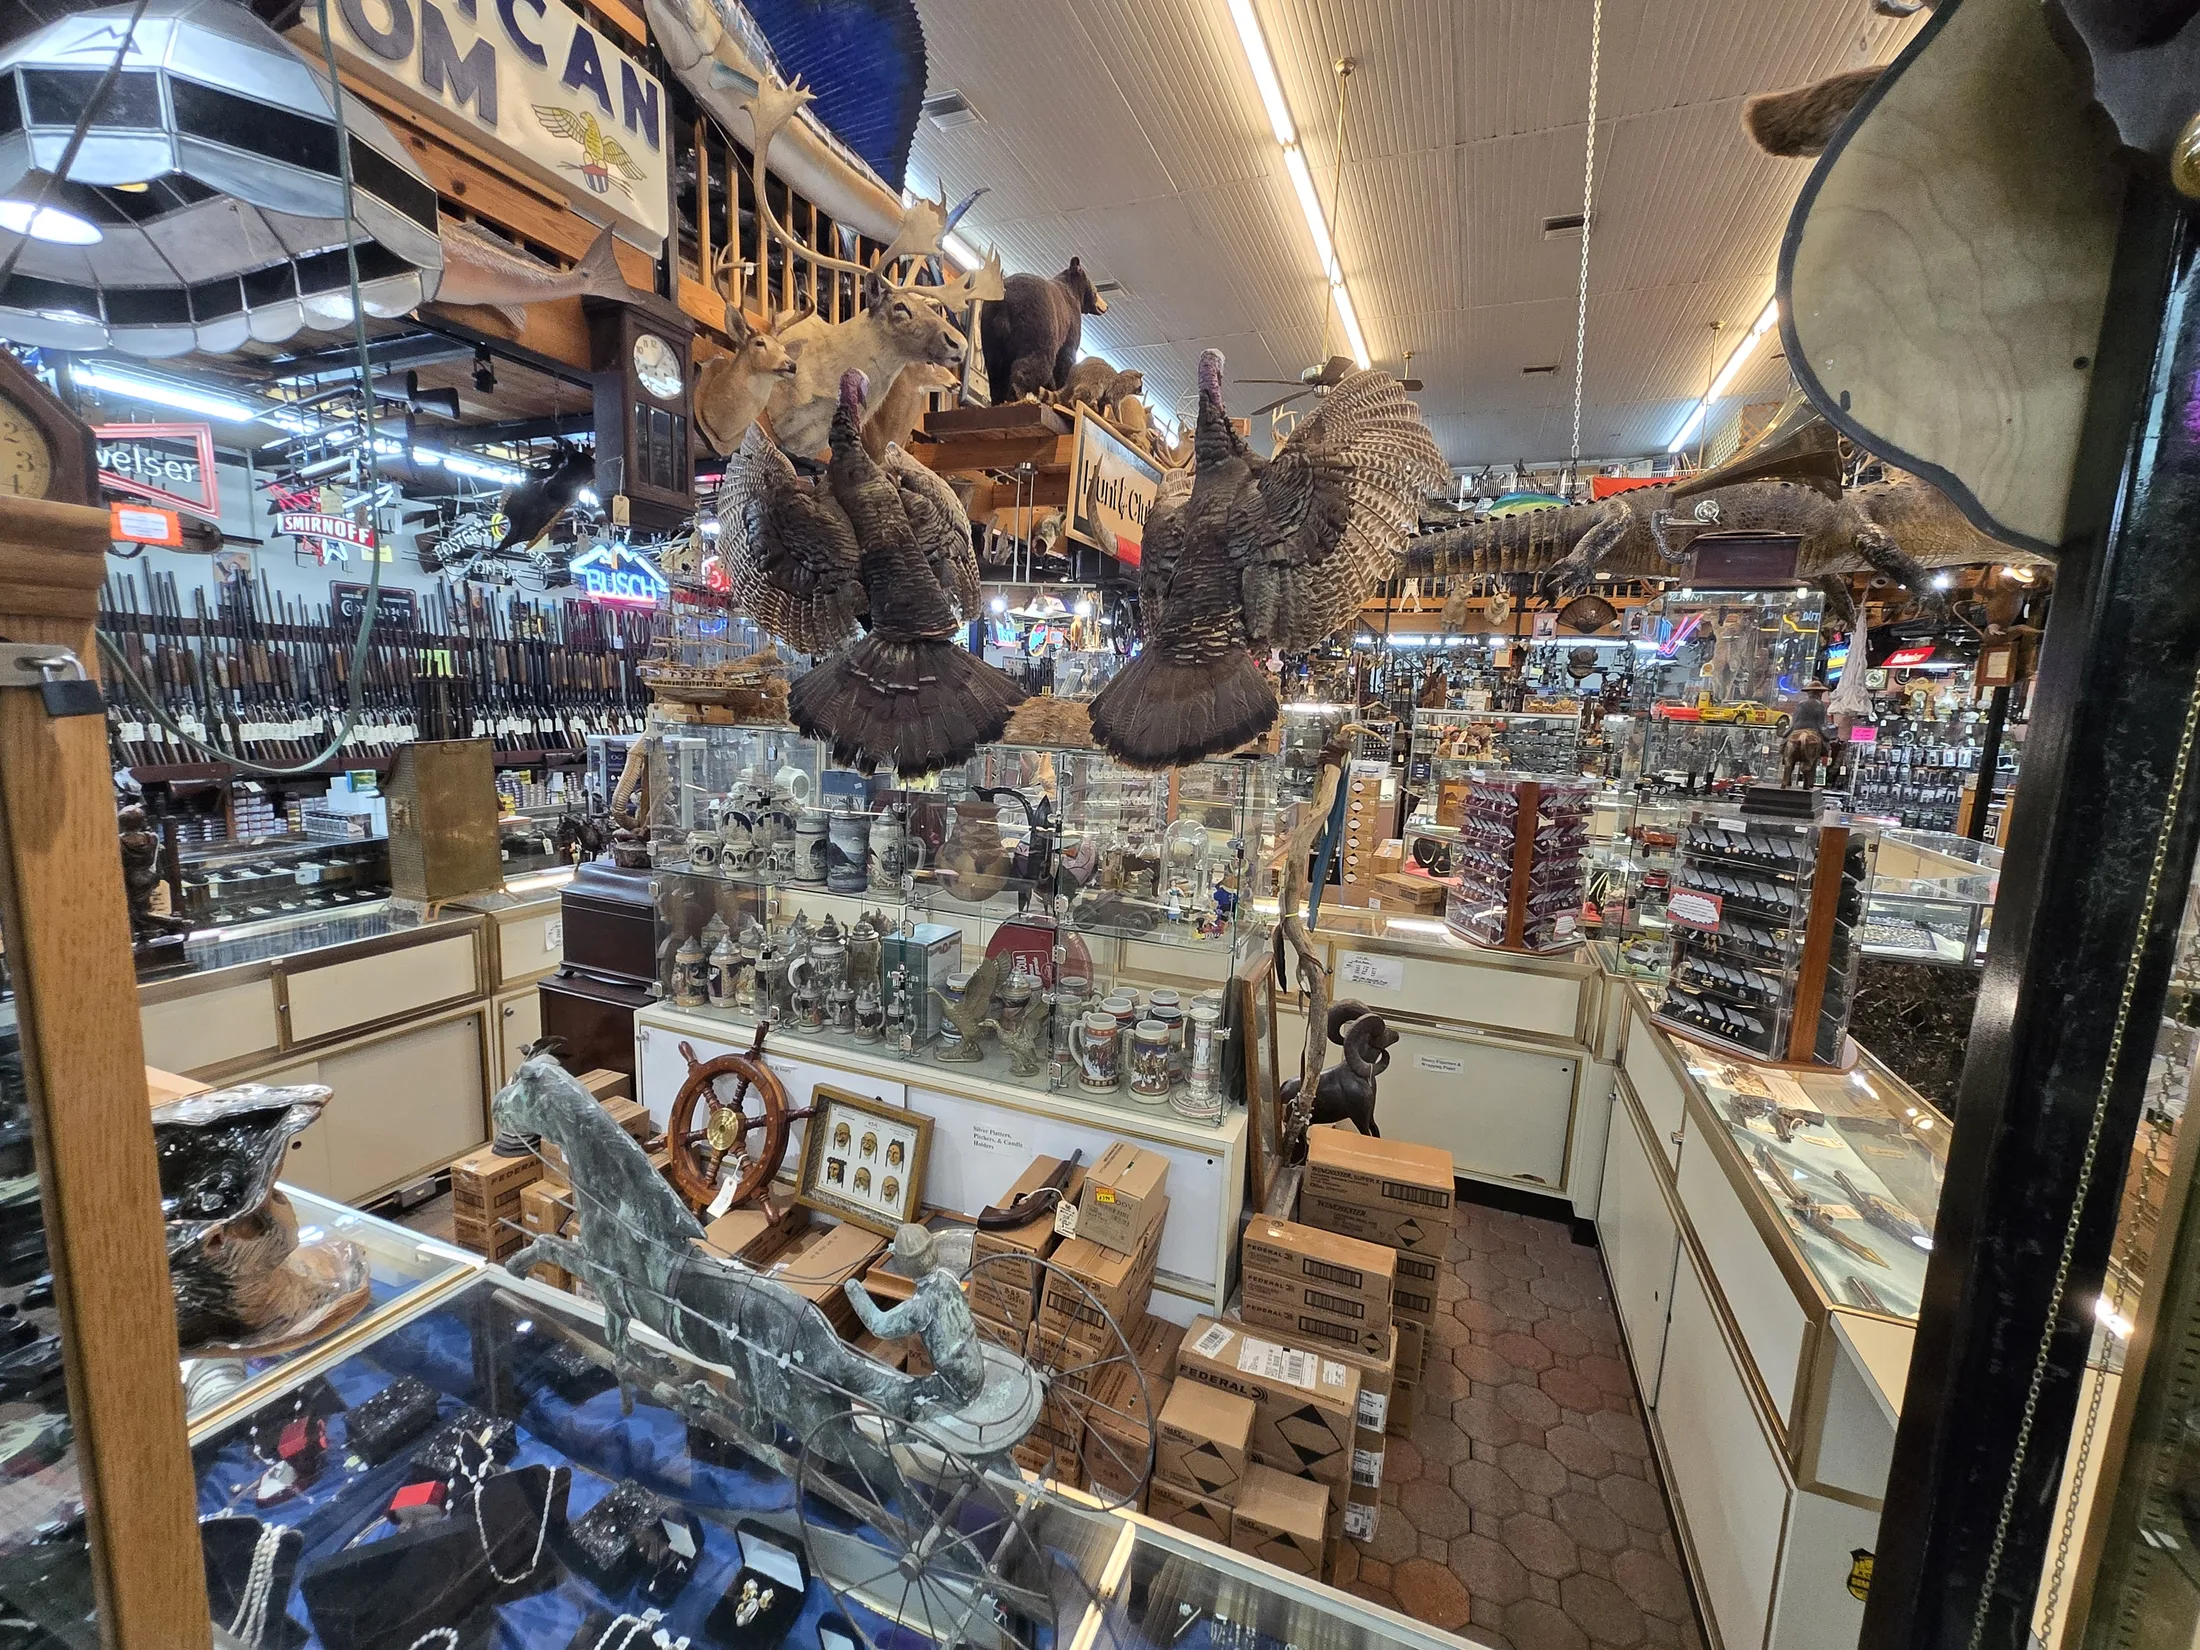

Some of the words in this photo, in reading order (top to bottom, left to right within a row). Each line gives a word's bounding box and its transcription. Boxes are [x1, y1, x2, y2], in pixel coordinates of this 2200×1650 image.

[3, 421, 19, 444] 2
[15, 450, 34, 472] 3
[285, 516, 370, 544] SMIRNOFF
[586, 568, 657, 601] BUSCH
[1983, 824, 1996, 839] 20
[973, 1125, 989, 1134] Silver
[1003, 1139, 1023, 1148] Candle
[1317, 1200, 1368, 1218] WINCHESTER
[1246, 1243, 1283, 1258] FEDERAL
[1247, 1275, 1284, 1289] FEDERAL
[1246, 1304, 1283, 1318] FEDERAL
[1179, 1364, 1247, 1395] FEDERAL
